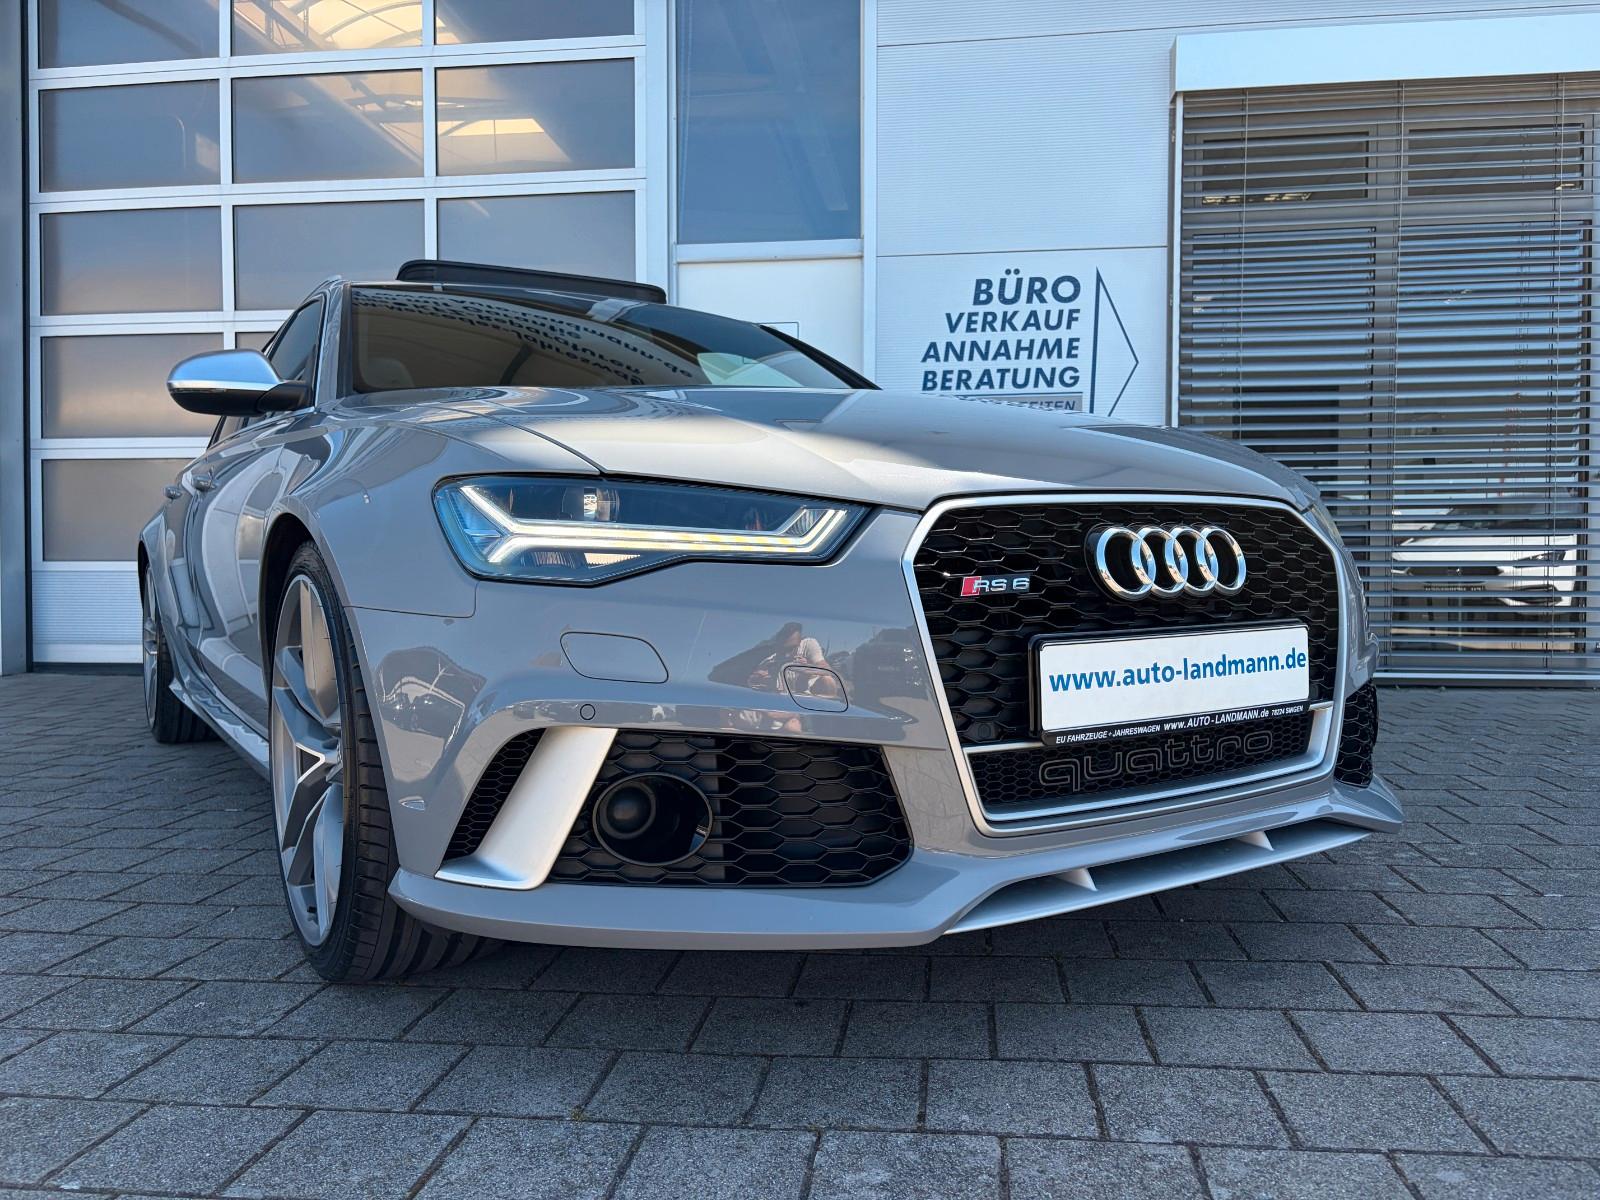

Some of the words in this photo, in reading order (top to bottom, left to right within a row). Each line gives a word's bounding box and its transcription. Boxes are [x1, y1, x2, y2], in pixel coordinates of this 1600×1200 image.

[973, 268, 1081, 306] BÜRO
[945, 308, 1081, 334] VERKAUF
[920, 337, 1081, 363] ANNAHME
[921, 366, 1080, 392] BERATUNG
[1049, 647, 1307, 692] www.auto-landmann.de
[1056, 735, 1066, 744] EU
[1066, 730, 1108, 743] FAHRZEUGE
[1112, 724, 1161, 738] JAHRESWAGEN
[1039, 729, 1272, 792] quattro
